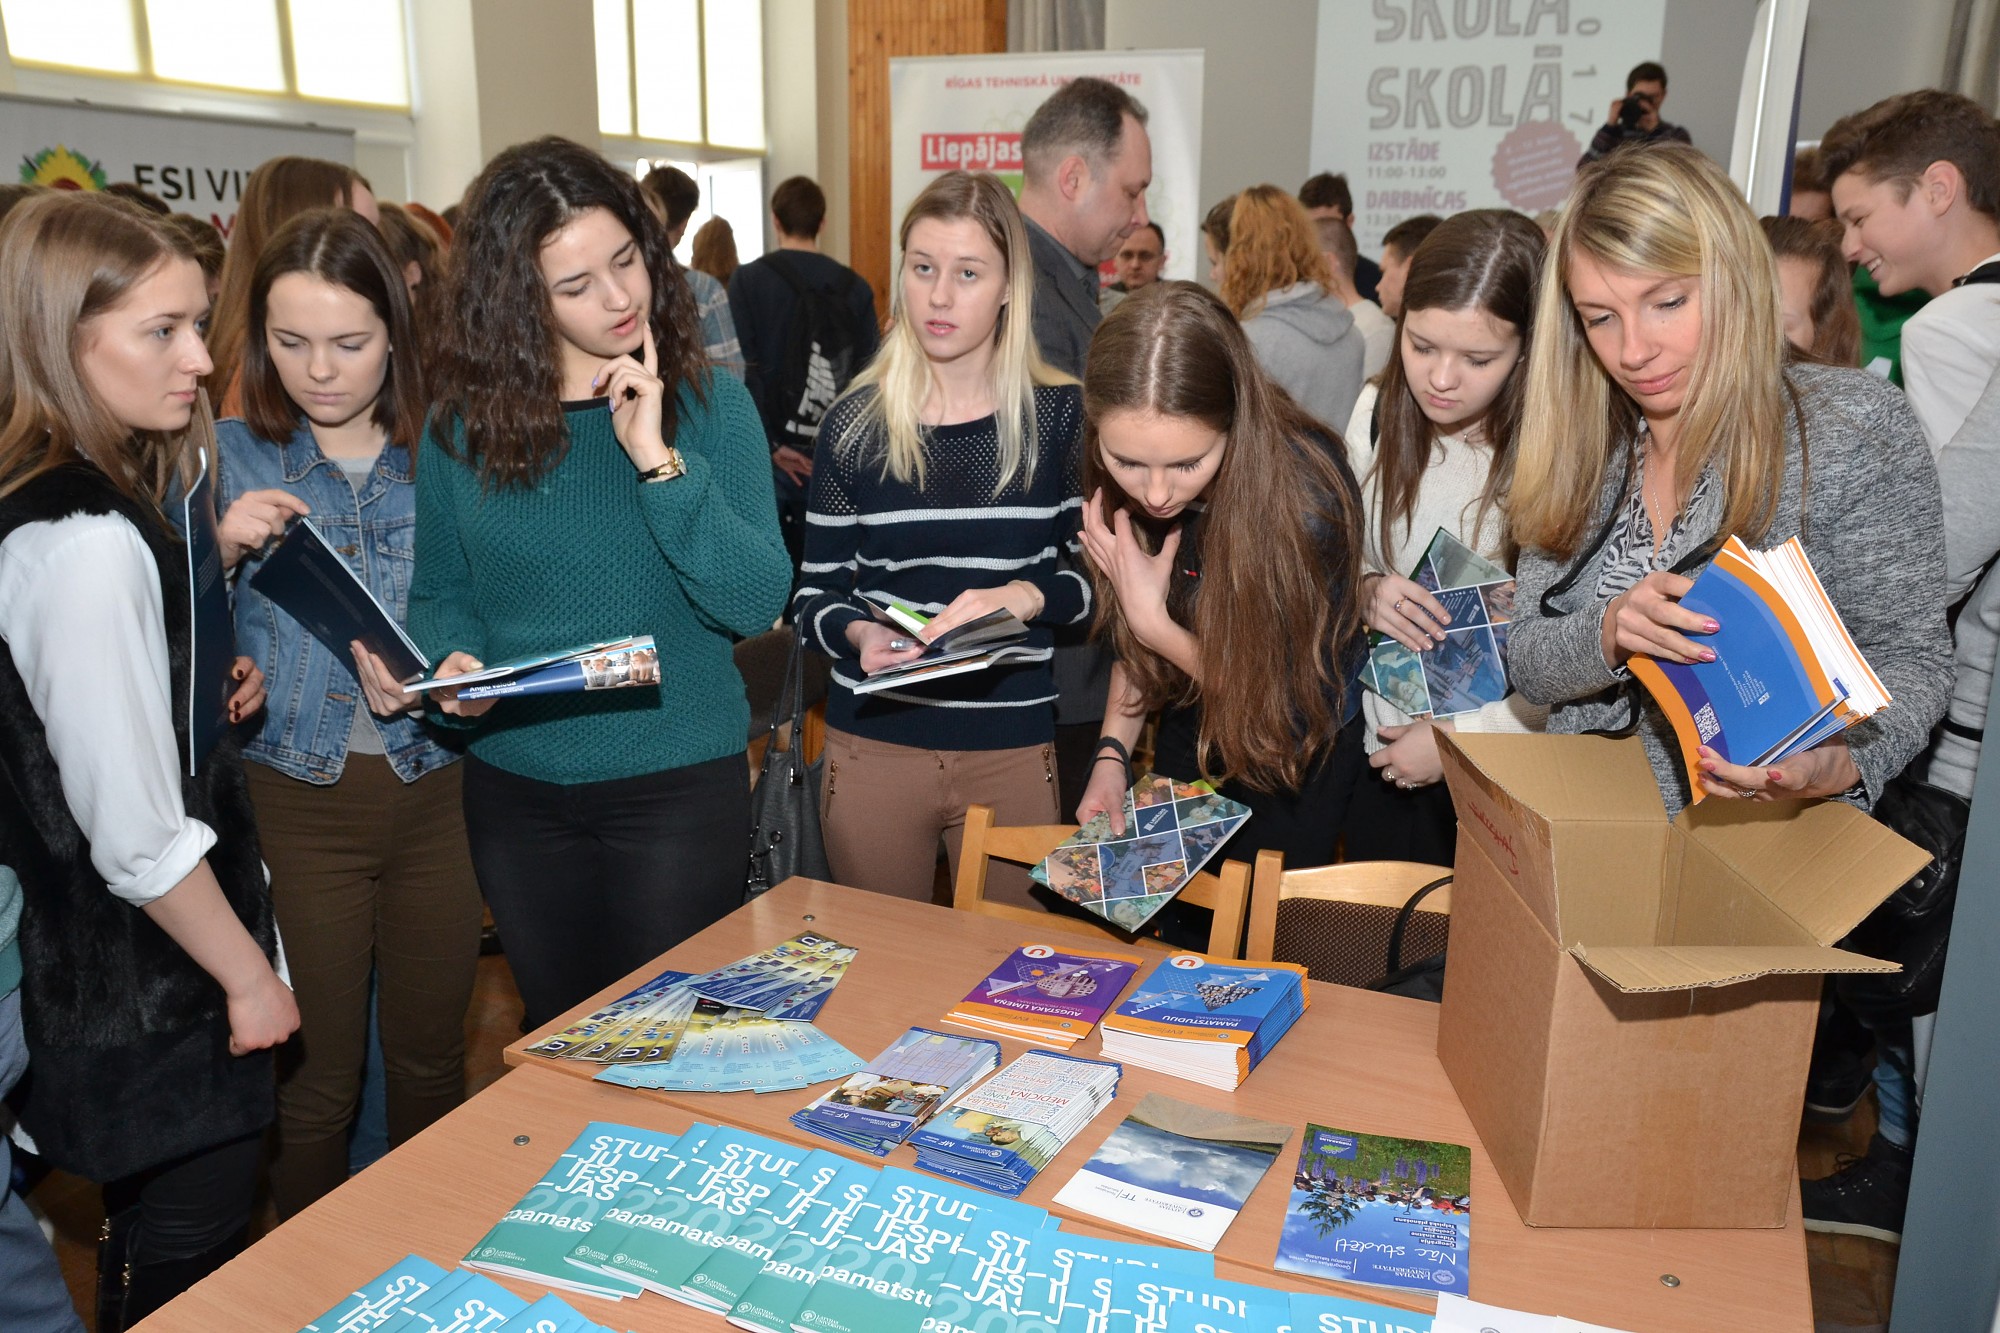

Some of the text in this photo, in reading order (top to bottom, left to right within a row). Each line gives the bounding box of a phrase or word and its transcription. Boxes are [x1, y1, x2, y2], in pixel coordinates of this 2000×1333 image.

[945, 74, 982, 89] RĪGAS
[985, 72, 1049, 88] TEHNISKĀ
[1367, 45, 1563, 130] SKOLĀ
[1368, 138, 1440, 161] IZSTĀDE
[1367, 165, 1446, 179] 11:00-13:00
[133, 164, 251, 202] ESI VI
[1366, 186, 1468, 210] DARBNĪCAS
[1162, 1015, 1240, 1028] PAMATSTUDIJU
[835, 1112, 849, 1120] KF
[938, 1140, 955, 1148] MF
[1414, 1247, 1457, 1266] Nāc
